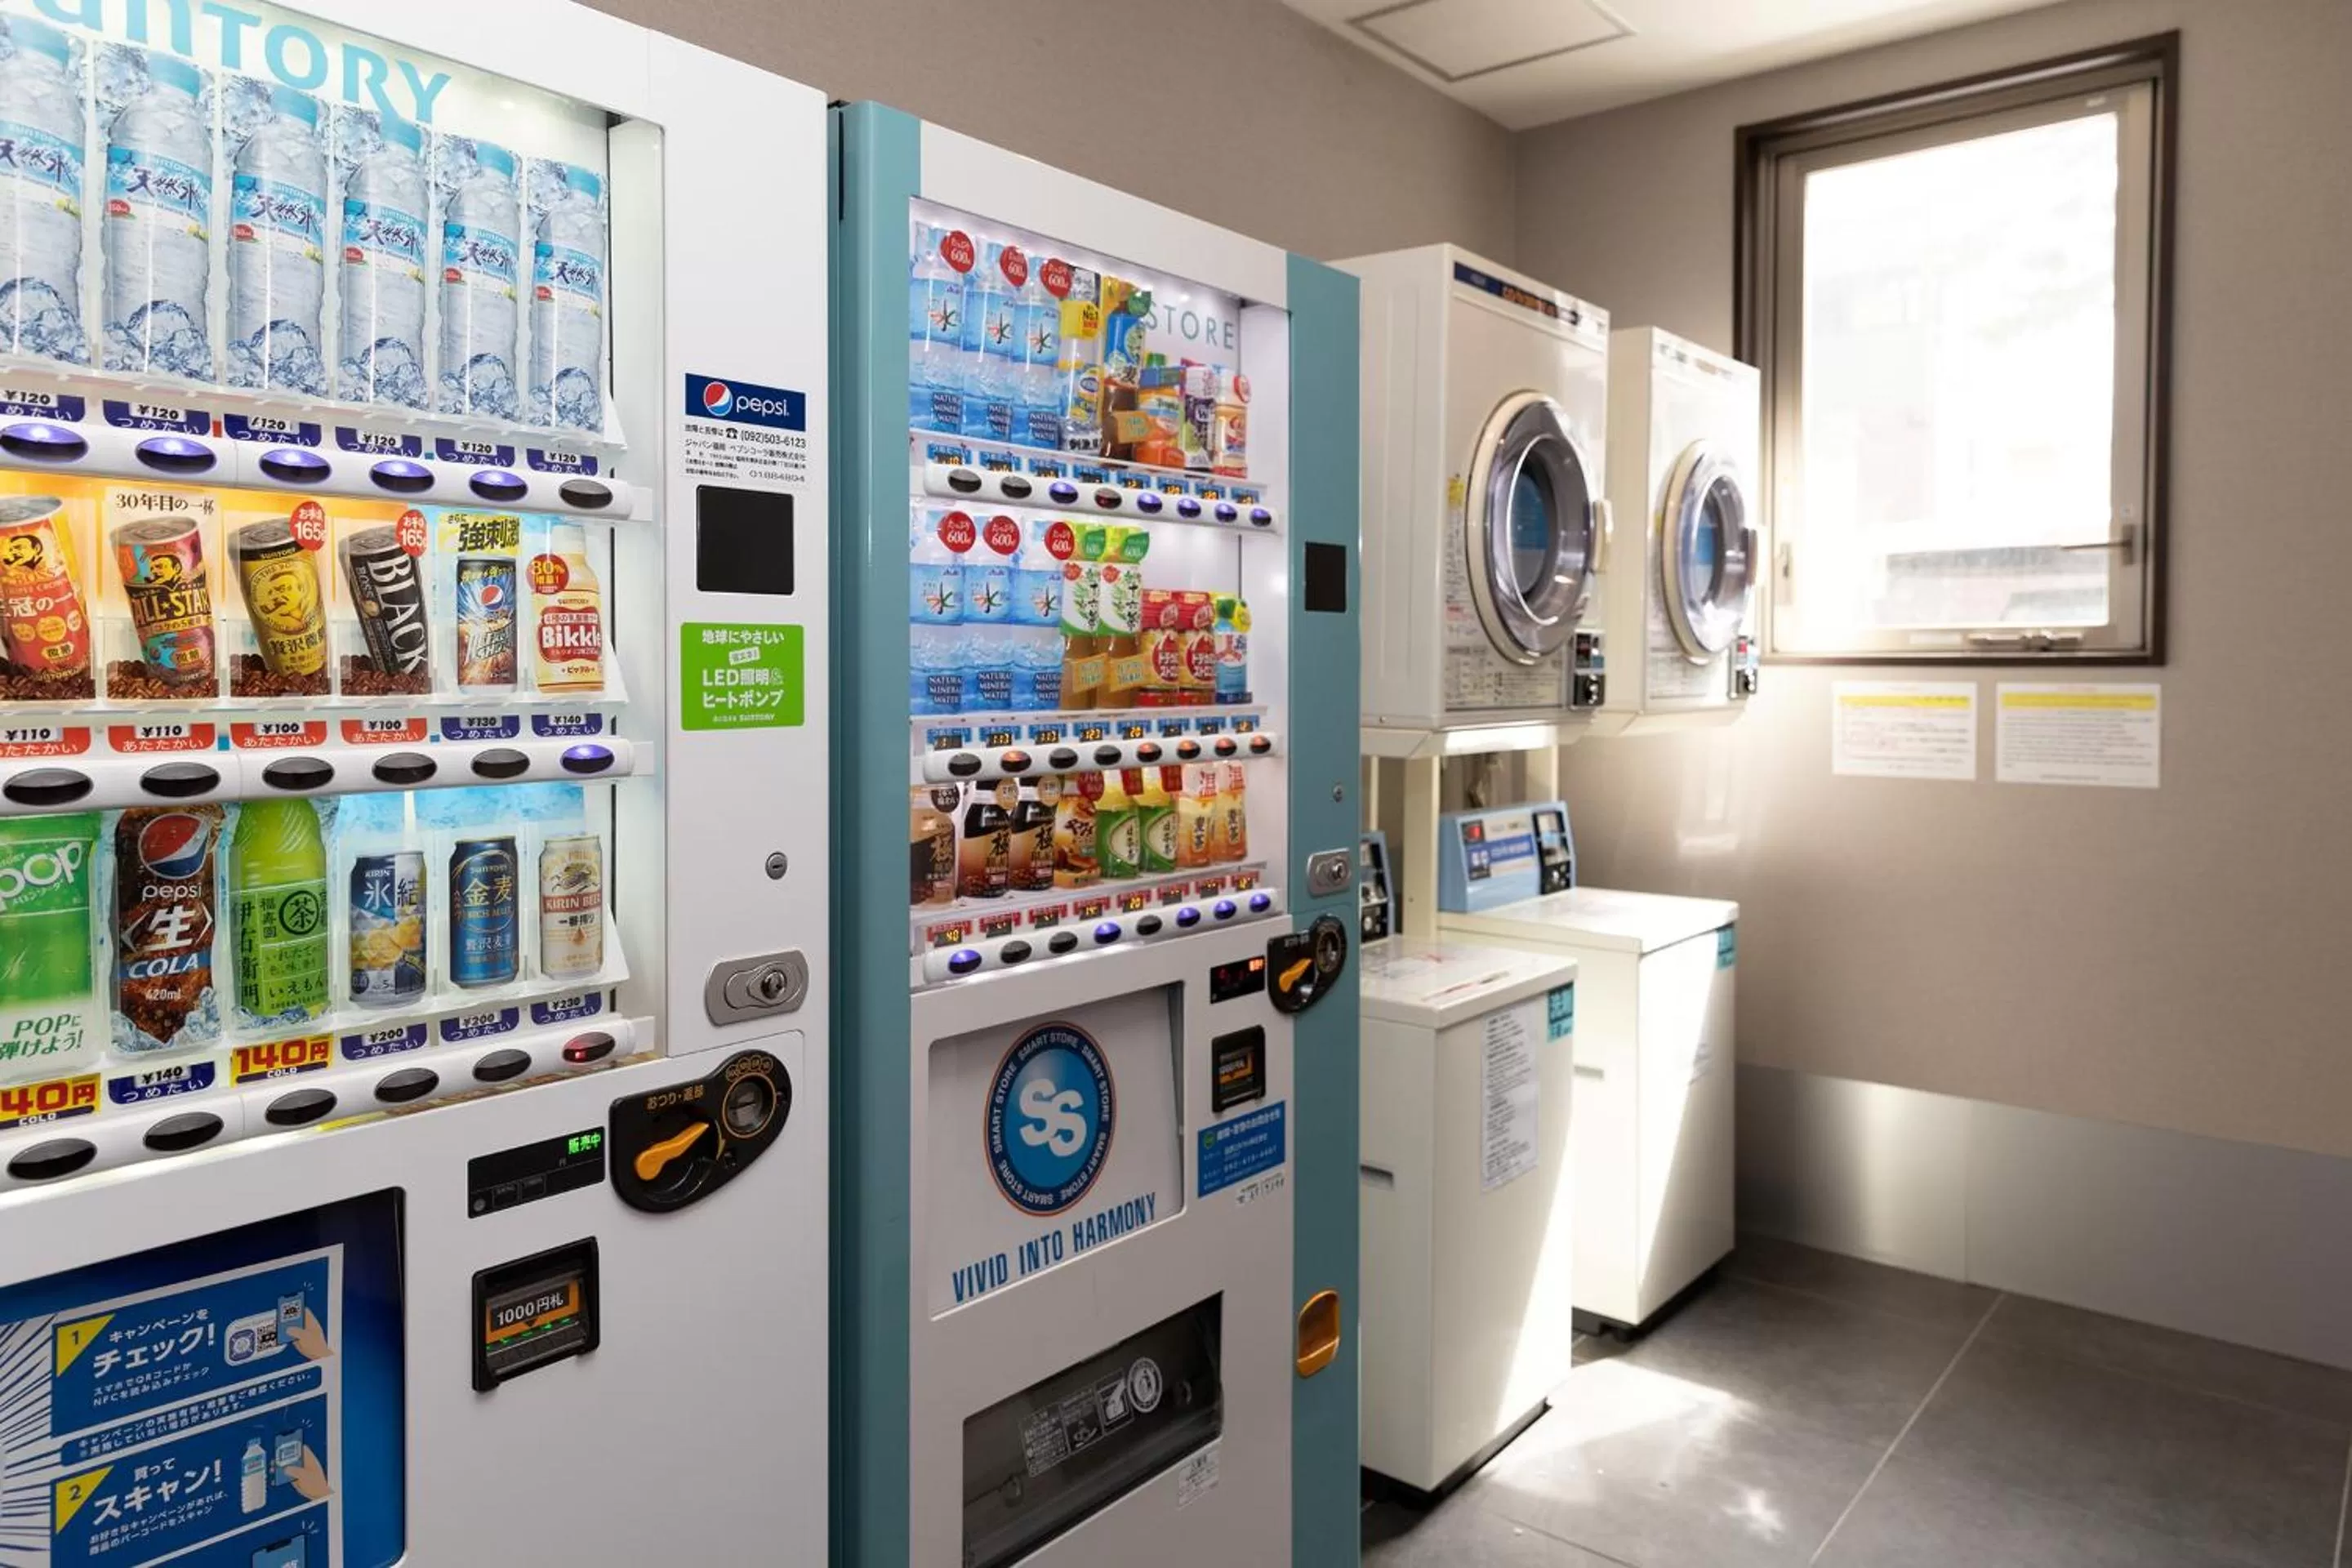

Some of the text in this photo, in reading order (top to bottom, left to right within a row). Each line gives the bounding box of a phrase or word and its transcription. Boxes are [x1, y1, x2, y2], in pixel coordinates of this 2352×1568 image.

[127, 167, 203, 211] 天然水
[250, 194, 321, 234] 天然水
[359, 219, 425, 256] 天然水
[461, 241, 518, 276] 天然水
[549, 261, 599, 294] 天然水
[1145, 301, 1235, 351] STORE
[3, 390, 51, 405] ¥120
[736, 395, 790, 417] pepsi
[136, 403, 179, 419] ¥120
[118, 416, 199, 435] つめたい
[237, 430, 311, 447] つめたい
[363, 434, 397, 447] ¥120
[461, 442, 492, 454] ¥120
[740, 429, 807, 449] (092)503-6123
[445, 452, 509, 466] つめたい
[548, 452, 577, 464] ¥120
[537, 462, 591, 475] つめたい
[115, 493, 215, 515] 30年目の一杯
[457, 518, 520, 553] 強刺激
[368, 552, 428, 676] BLACK
[702, 628, 786, 645] 地球にやさしい
[702, 688, 785, 709] ヒートポンプ
[263, 723, 300, 734] ¥100
[368, 719, 403, 731] ¥100
[466, 717, 497, 728] ¥130
[554, 715, 582, 725] ¥140
[6, 728, 51, 741] ¥110
[142, 725, 182, 737] ¥110
[451, 728, 513, 739] つめたい
[540, 725, 596, 736] つめたい
[122, 738, 205, 753] あたたかい
[245, 737, 318, 747] あたたかい
[142, 883, 203, 902] pepsi
[363, 877, 420, 913] 氷結
[461, 875, 513, 907] 金麦
[288, 898, 316, 930] 茶
[546, 898, 580, 911] KIRIN
[144, 903, 197, 952] 生
[128, 952, 199, 980] COLA
[145, 988, 181, 1002] 420ml
[551, 996, 581, 1010] ¥230
[462, 1013, 496, 1027] ¥200
[541, 1006, 595, 1023] つめたい
[369, 1028, 404, 1044] ¥200
[452, 1021, 512, 1039] つめたい
[352, 1038, 419, 1059] つめたい
[1018, 1031, 1080, 1060] SMART STORE
[235, 1038, 330, 1075] 140円
[142, 1065, 184, 1085] ¥140
[266, 1067, 298, 1079] COLD
[122, 1078, 205, 1102] つめたい
[1081, 1045, 1110, 1122] SMART STORE
[991, 1062, 1017, 1155] SMART STORE
[1019, 1078, 1087, 1157] SS
[19, 1112, 57, 1126] COLD
[568, 1132, 602, 1155] 販売中
[1060, 1131, 1107, 1201] SMART STORE
[998, 1159, 1054, 1205] SMART STORE
[952, 1192, 1157, 1303] VIVID INTO HARMONY
[497, 1292, 564, 1326] 1000円札
[109, 1308, 210, 1343] キャンペーンを
[71, 1330, 79, 1346] 1
[93, 1321, 216, 1379] チェック!
[133, 1457, 176, 1483] 買って
[69, 1483, 82, 1502] 2
[92, 1458, 222, 1526] スキャン!
